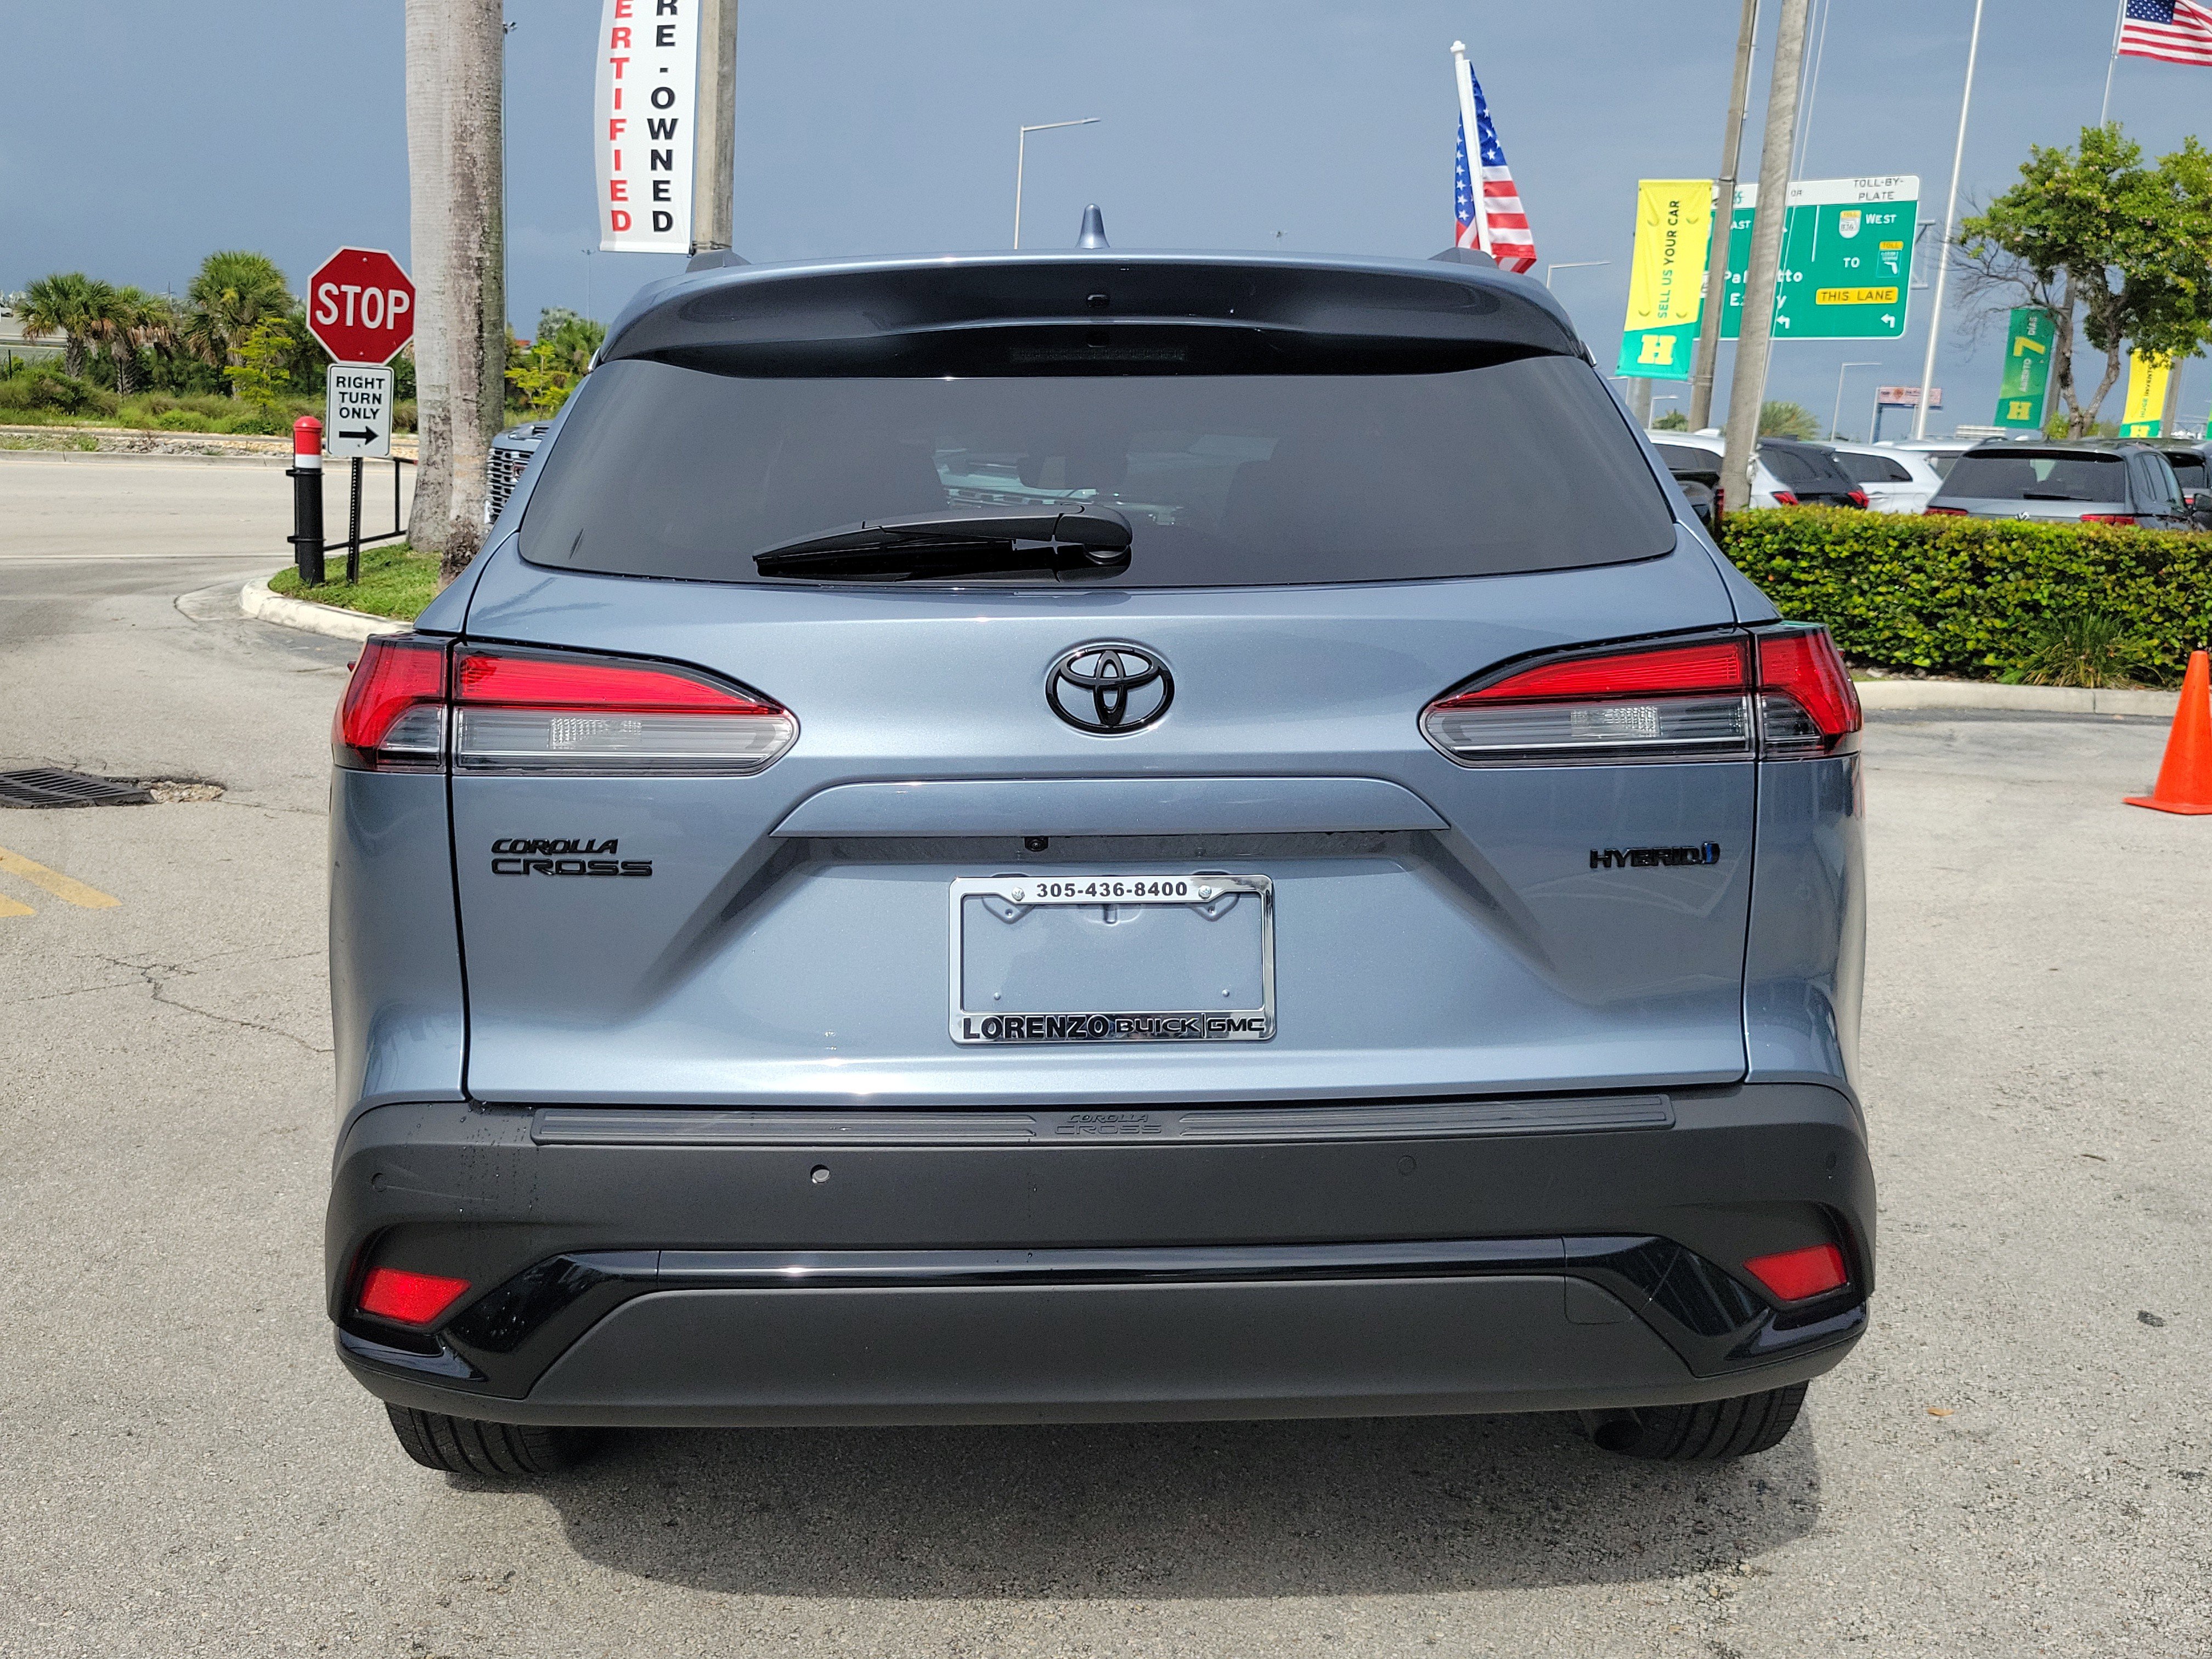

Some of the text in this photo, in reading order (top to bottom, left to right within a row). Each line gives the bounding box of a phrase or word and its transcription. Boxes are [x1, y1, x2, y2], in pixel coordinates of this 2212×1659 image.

[1858, 191, 1895, 201] PLATE
[1730, 220, 1752, 230] AST
[1866, 213, 1897, 224] WEST
[1657, 200, 1681, 319] SELL US YOUR CAR
[1843, 257, 1860, 268] TO
[1821, 290, 1894, 301] THIS LANE
[315, 282, 410, 330] STOP
[1637, 334, 1678, 365] H
[2013, 336, 2046, 357] 7
[336, 376, 386, 390] RIGHT
[338, 391, 382, 405] TURN
[339, 406, 381, 420] ONLY
[491, 838, 619, 855] COROLLA
[1589, 846, 1701, 868] HYBRID
[491, 857, 653, 877] CROSS
[1036, 881, 1188, 898] 305-436-8400
[962, 1014, 1266, 1040] LORENZO BUICK GMC
[1067, 1114, 1149, 1123] COROLLA
[1054, 1124, 1162, 1135] CROSS
